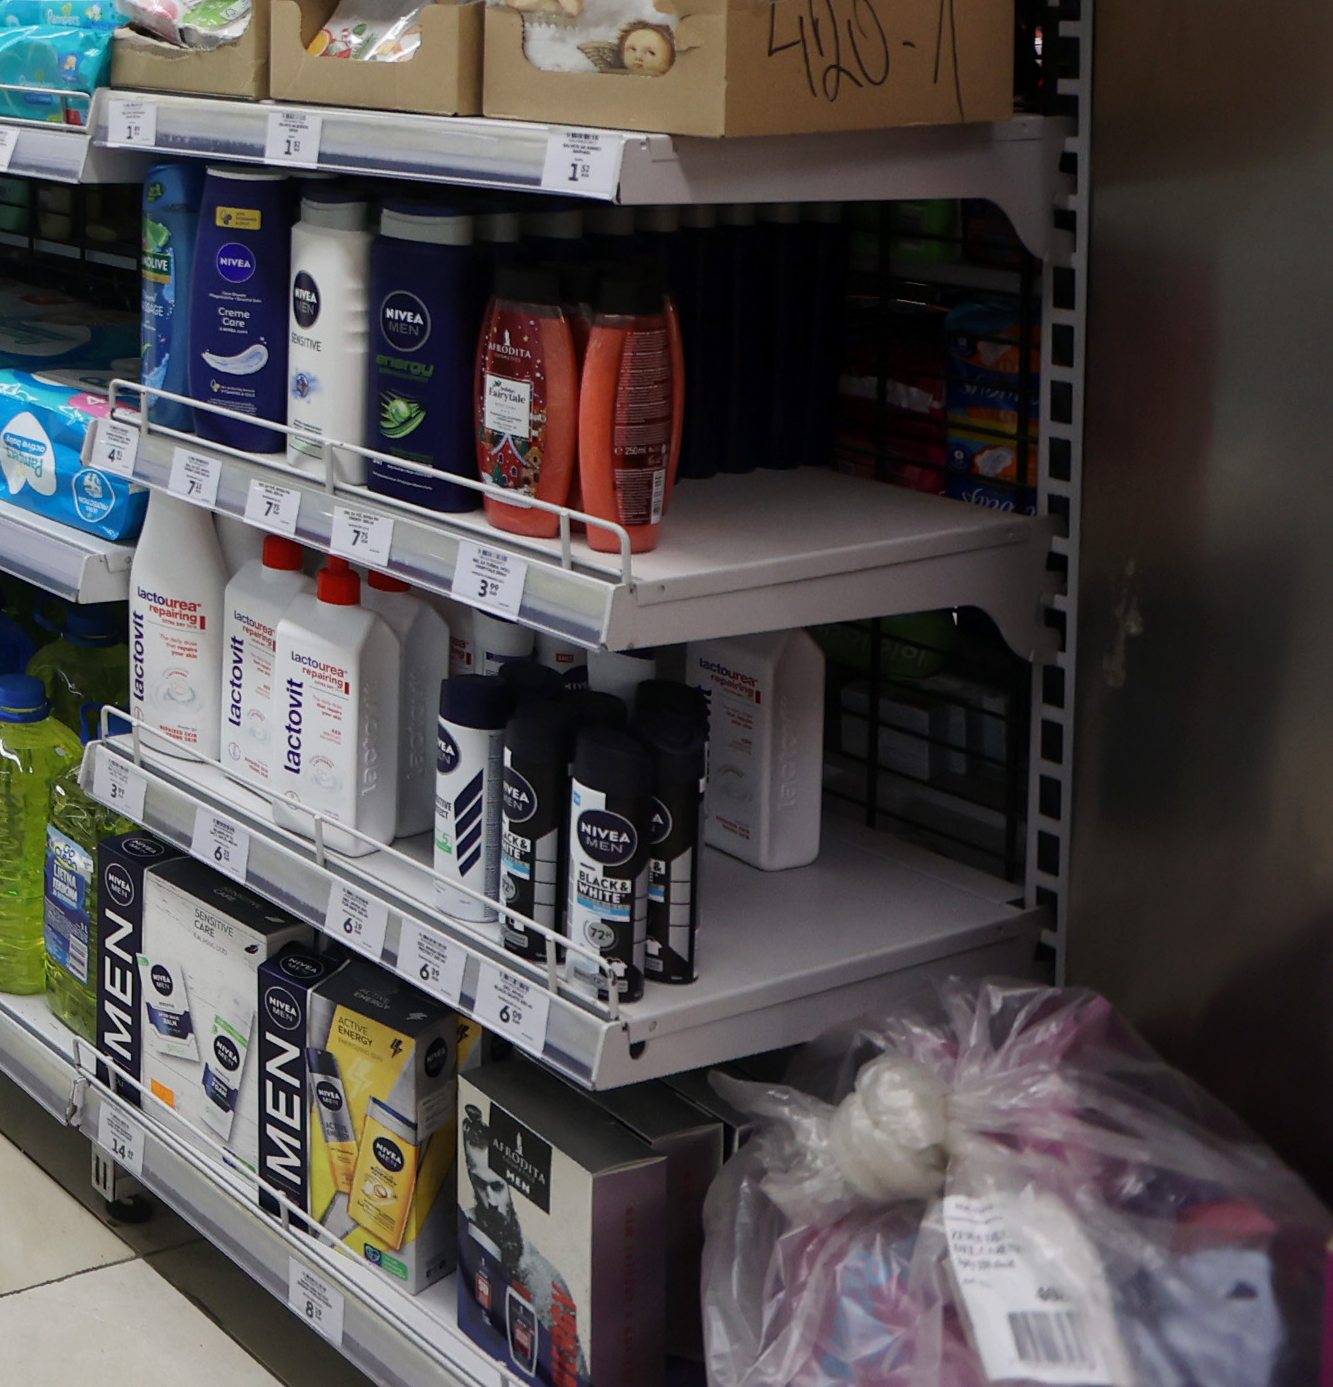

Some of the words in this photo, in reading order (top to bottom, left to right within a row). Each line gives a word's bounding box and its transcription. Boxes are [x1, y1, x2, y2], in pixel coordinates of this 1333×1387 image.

[568, 163, 579, 182] 1
[219, 256, 251, 270] NIVEA
[294, 286, 318, 304] NIVEA
[217, 306, 251, 319] Creme
[296, 300, 315, 316] MEN
[385, 307, 424, 325] NIVEA
[221, 316, 246, 328] Care
[388, 319, 420, 337] MEN
[290, 331, 322, 352] SENSITIVE
[488, 343, 532, 360] AFRODITA
[488, 386, 527, 405] Fairytale
[107, 448, 116, 463] 4
[187, 479, 197, 495] 7
[264, 500, 274, 517] 7
[351, 529, 361, 546] 7
[137, 585, 202, 612] lactourea
[477, 579, 489, 598] 3
[148, 603, 198, 626] repairing
[233, 609, 276, 635] lactourea
[242, 624, 273, 646] repairing
[132, 611, 145, 703] lactovit
[290, 650, 348, 678] lactourea
[228, 635, 245, 727] lactovit
[301, 666, 344, 689] repairing
[283, 677, 304, 775] lactovit
[581, 821, 632, 845] NIVEA
[214, 845, 223, 862] 6
[586, 836, 624, 855] MEN
[107, 872, 131, 893] NIVEA
[110, 882, 129, 898] MEN
[578, 868, 618, 893] BLACK
[619, 877, 630, 893] &
[577, 881, 625, 905] WHITE
[193, 918, 215, 939] CARE
[194, 907, 234, 938] SENSITIVE
[343, 917, 353, 934] 6
[153, 972, 172, 986] NIVEA
[419, 963, 430, 981] 6
[102, 907, 135, 1061] MEN
[269, 995, 298, 1018] NIVEA
[272, 1007, 296, 1024] MEN
[499, 1005, 511, 1023] 6
[338, 1015, 369, 1035] ACTIVE
[337, 1025, 374, 1047] ENERGY
[214, 1041, 239, 1063] NIVEA
[264, 1031, 304, 1185] MEN
[374, 1142, 402, 1164] NIVEA
[492, 1135, 547, 1185] AFRODITA
[505, 1169, 531, 1195] MEN
[305, 1300, 314, 1319] 8
